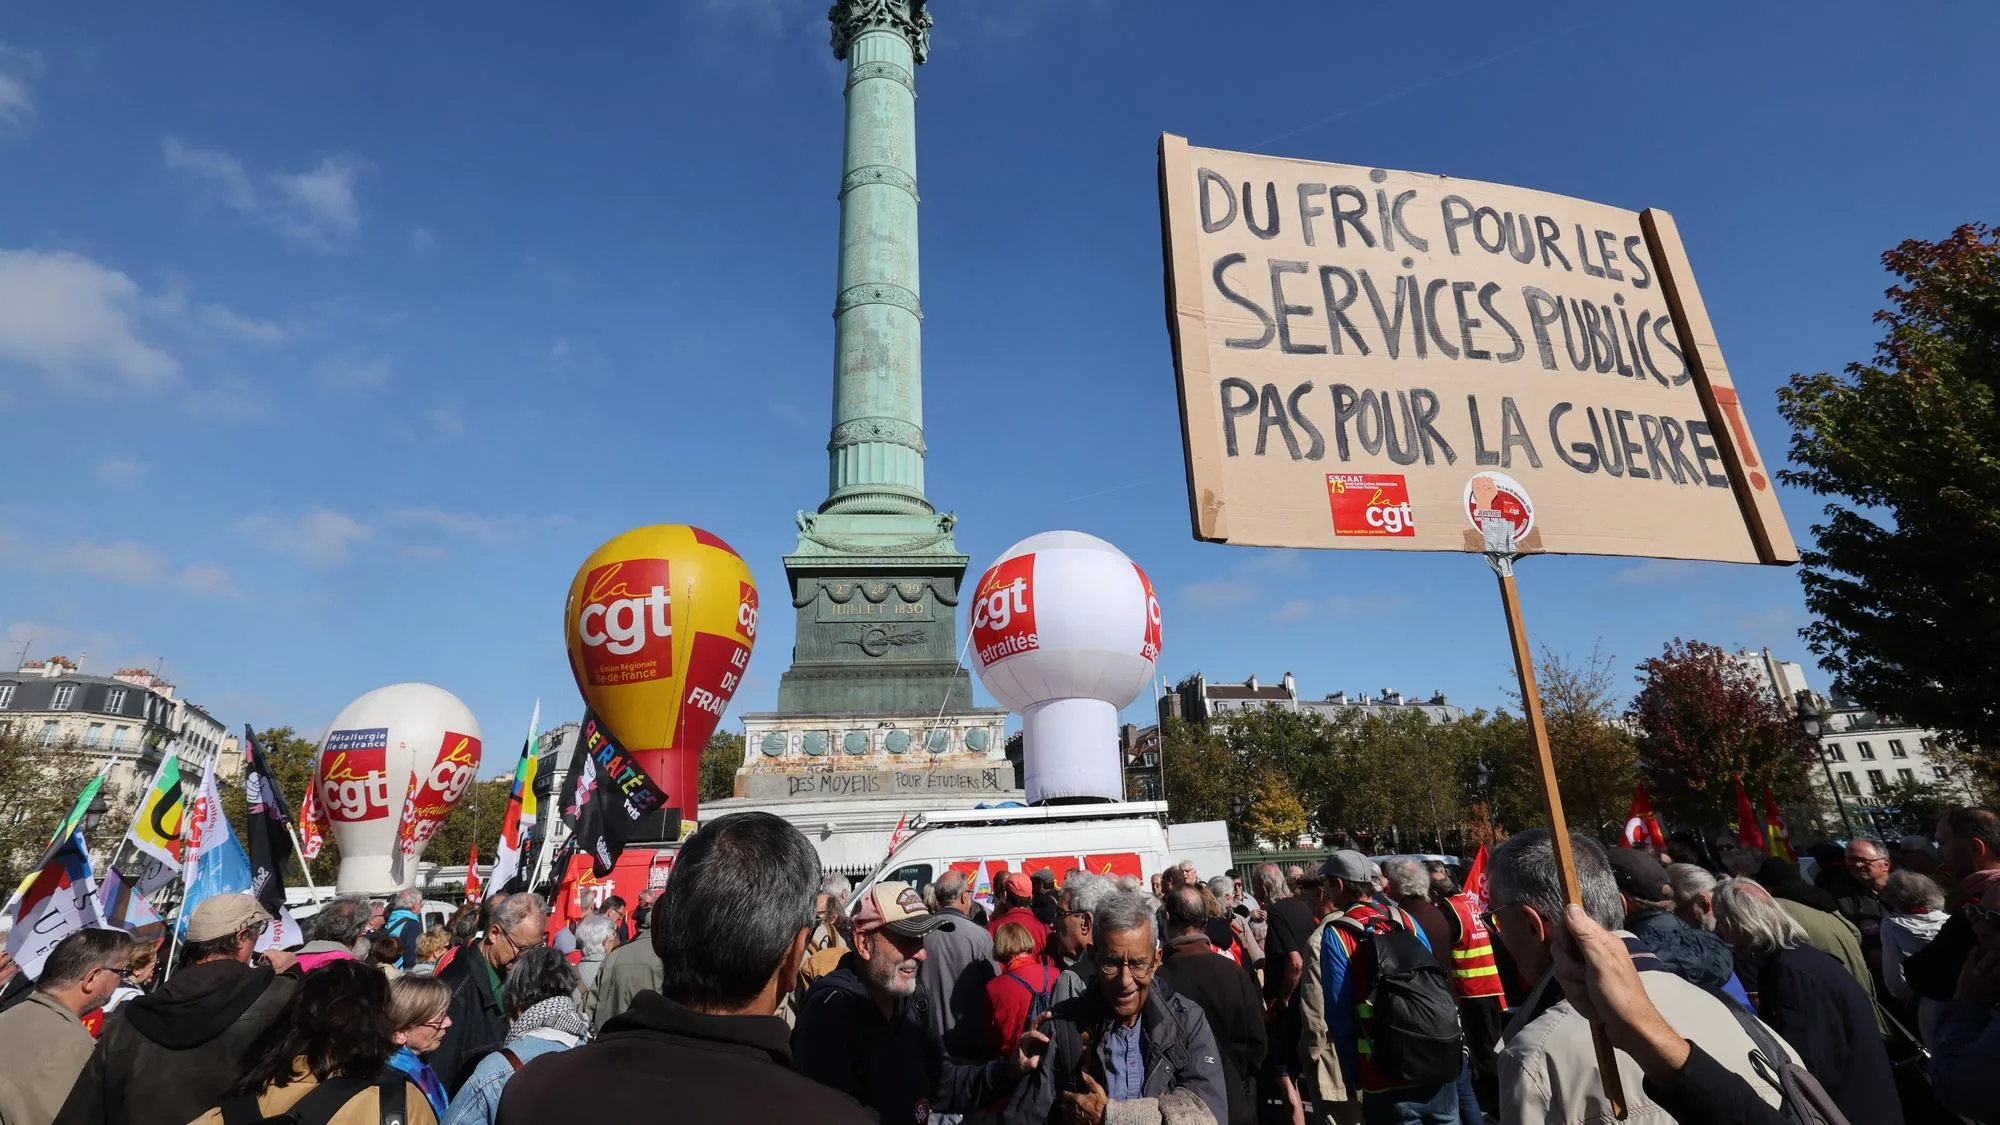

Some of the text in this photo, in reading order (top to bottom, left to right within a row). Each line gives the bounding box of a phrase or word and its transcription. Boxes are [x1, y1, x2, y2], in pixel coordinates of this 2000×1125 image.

[1198, 166, 1280, 240] DU
[1441, 193, 1574, 272] POUR
[1575, 223, 1651, 289] LES
[1220, 377, 1325, 462] PAS
[1329, 382, 1458, 466] POUR
[1467, 394, 1543, 469] LA
[1549, 401, 1730, 489] GUERRE
[1328, 475, 1364, 483] SSCAAT
[1330, 480, 1345, 494] 75
[1367, 488, 1402, 507] la
[1365, 501, 1414, 533] cgt
[582, 562, 652, 607] la
[835, 584, 920, 595] 27 28 29
[976, 569, 1011, 600] la
[832, 603, 924, 615] JUILLET 1830
[974, 577, 1028, 631] cgt
[579, 585, 672, 655] cgt
[731, 647, 749, 669] ILE
[978, 630, 1040, 664] retraités
[720, 671, 738, 693] DE
[687, 686, 729, 717] FRAN
[330, 732, 386, 742] Métallurgie
[338, 742, 349, 750] de
[351, 740, 386, 749] france
[323, 752, 370, 781] la
[442, 737, 475, 767] la
[321, 770, 389, 819] cgt
[787, 776, 816, 796] DES
[820, 774, 881, 795] MOYENS
[895, 771, 921, 789] POUR
[579, 867, 607, 885] la
